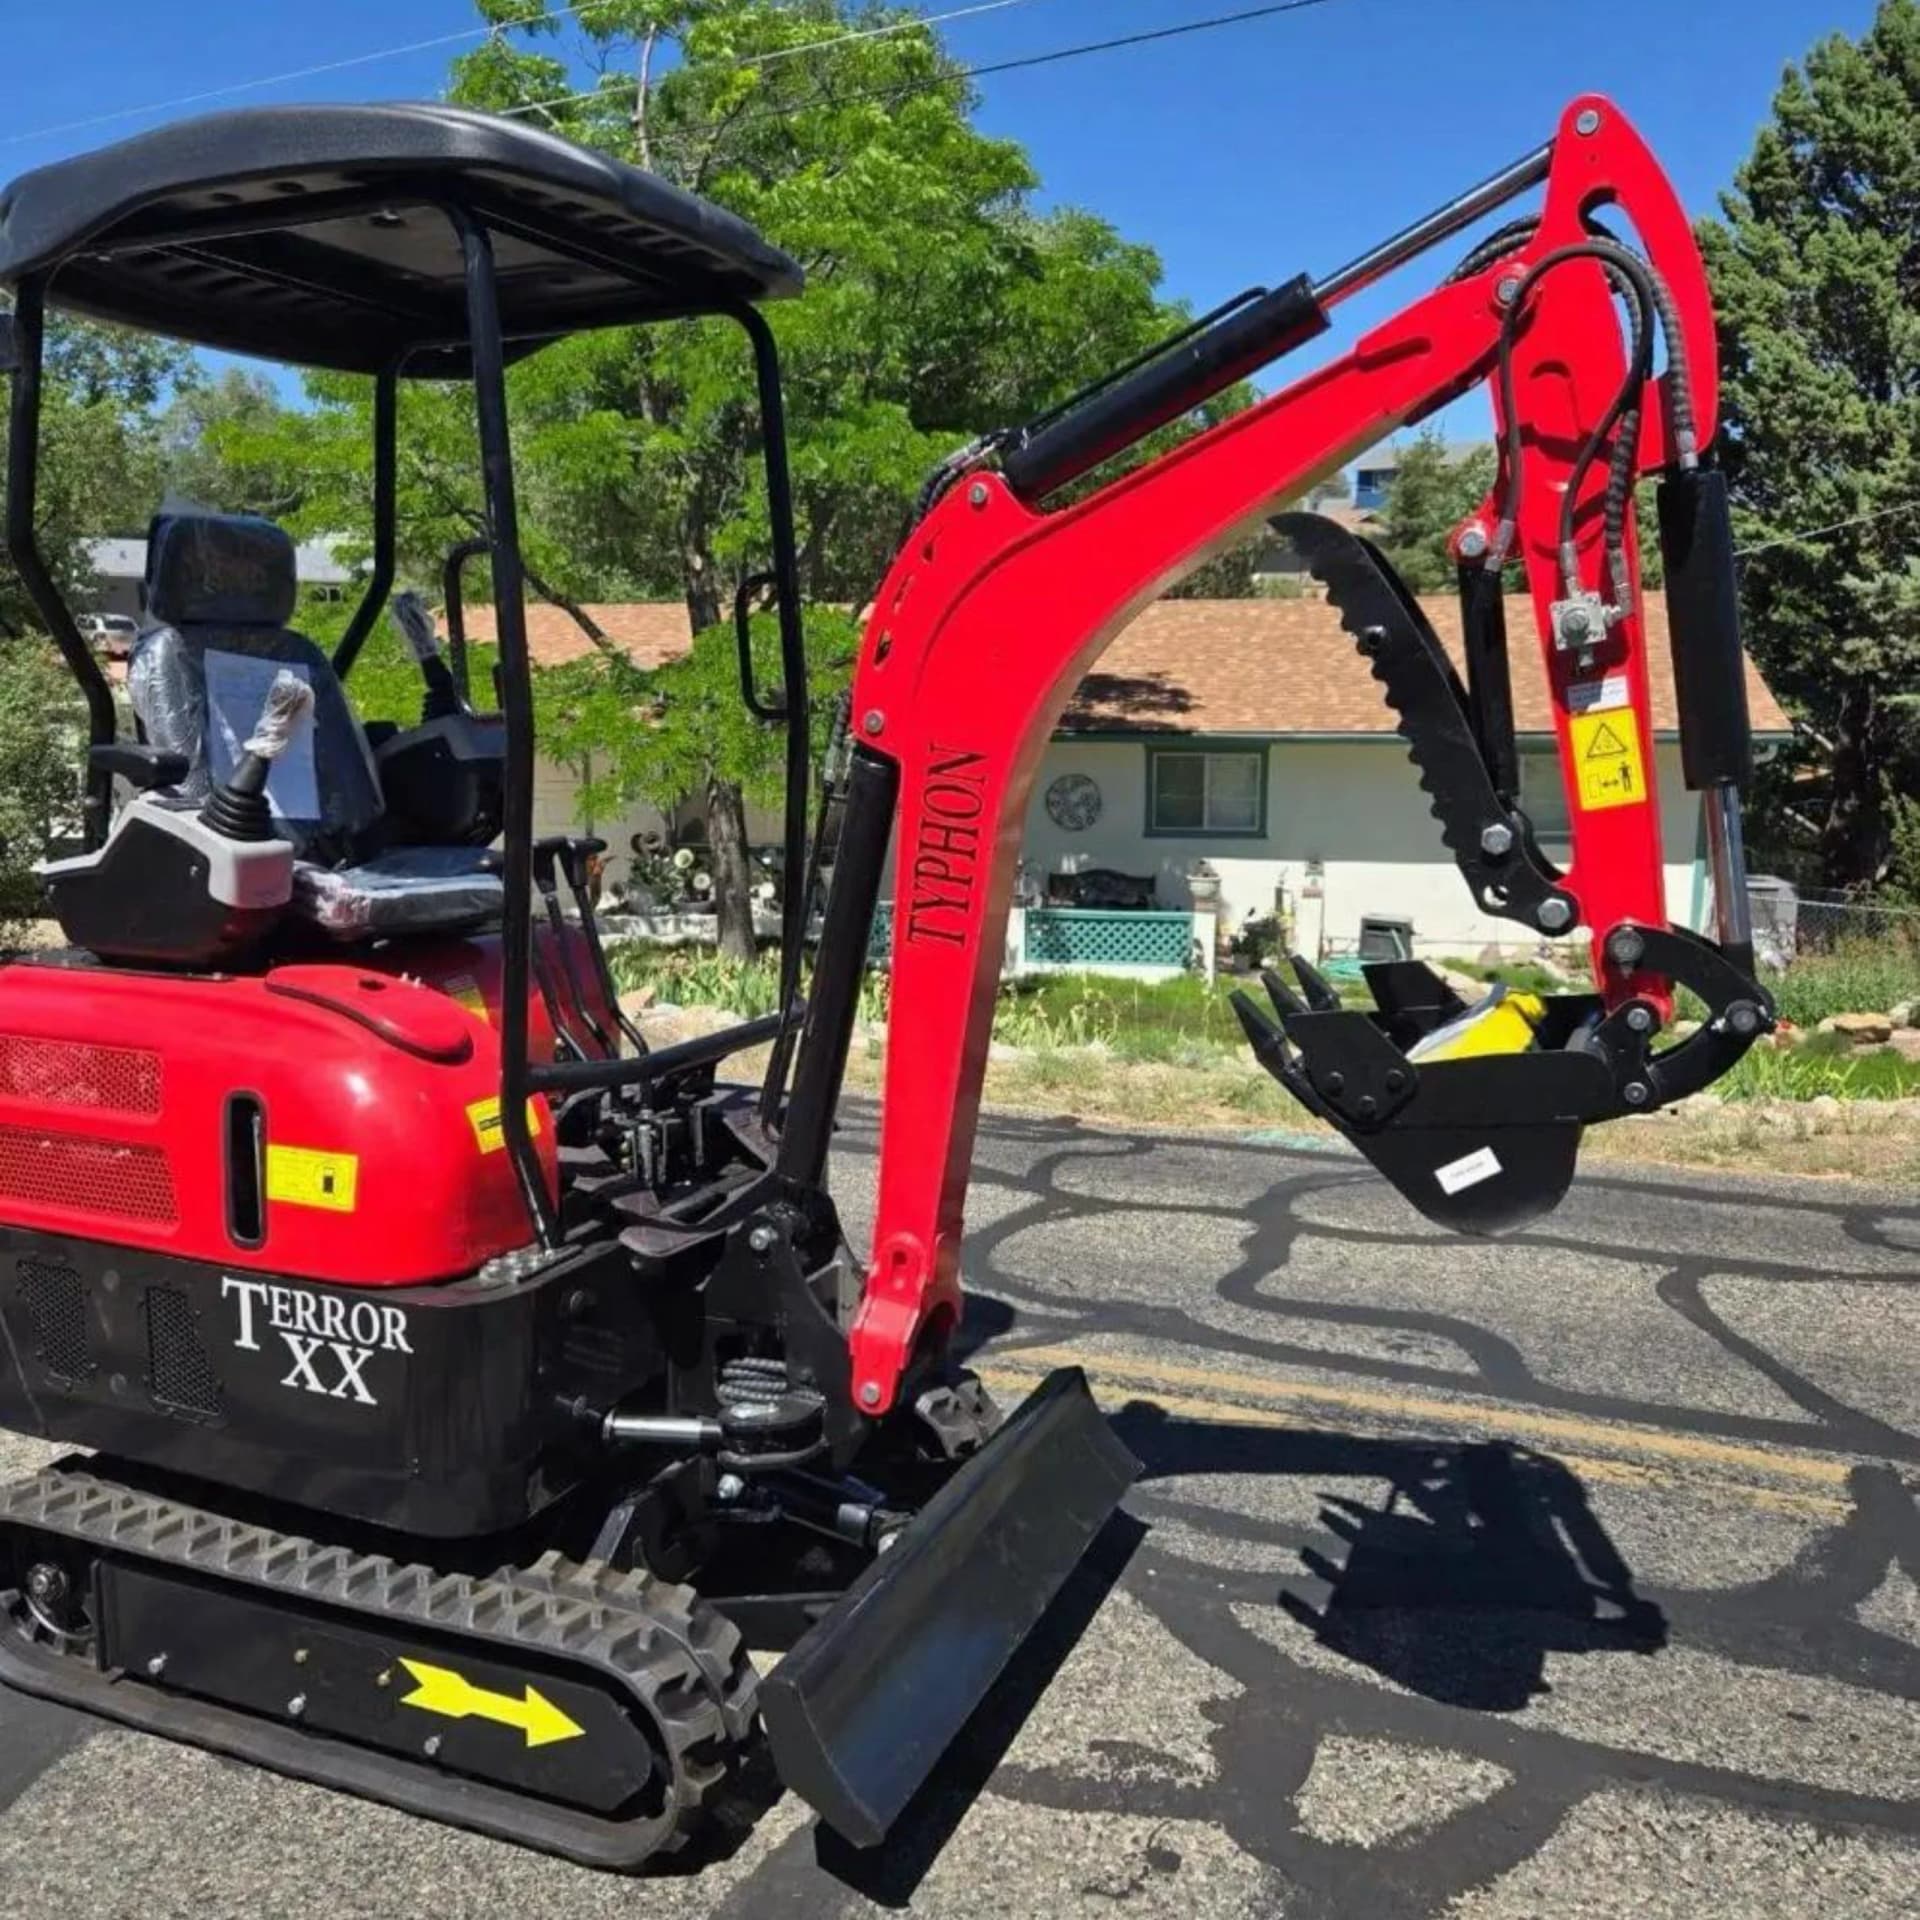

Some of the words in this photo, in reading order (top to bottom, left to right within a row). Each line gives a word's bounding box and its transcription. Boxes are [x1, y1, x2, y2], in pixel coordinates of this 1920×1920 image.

[907, 742, 988, 947] TYPHON
[221, 1276, 414, 1353] TERROR
[279, 1331, 378, 1405] XX
